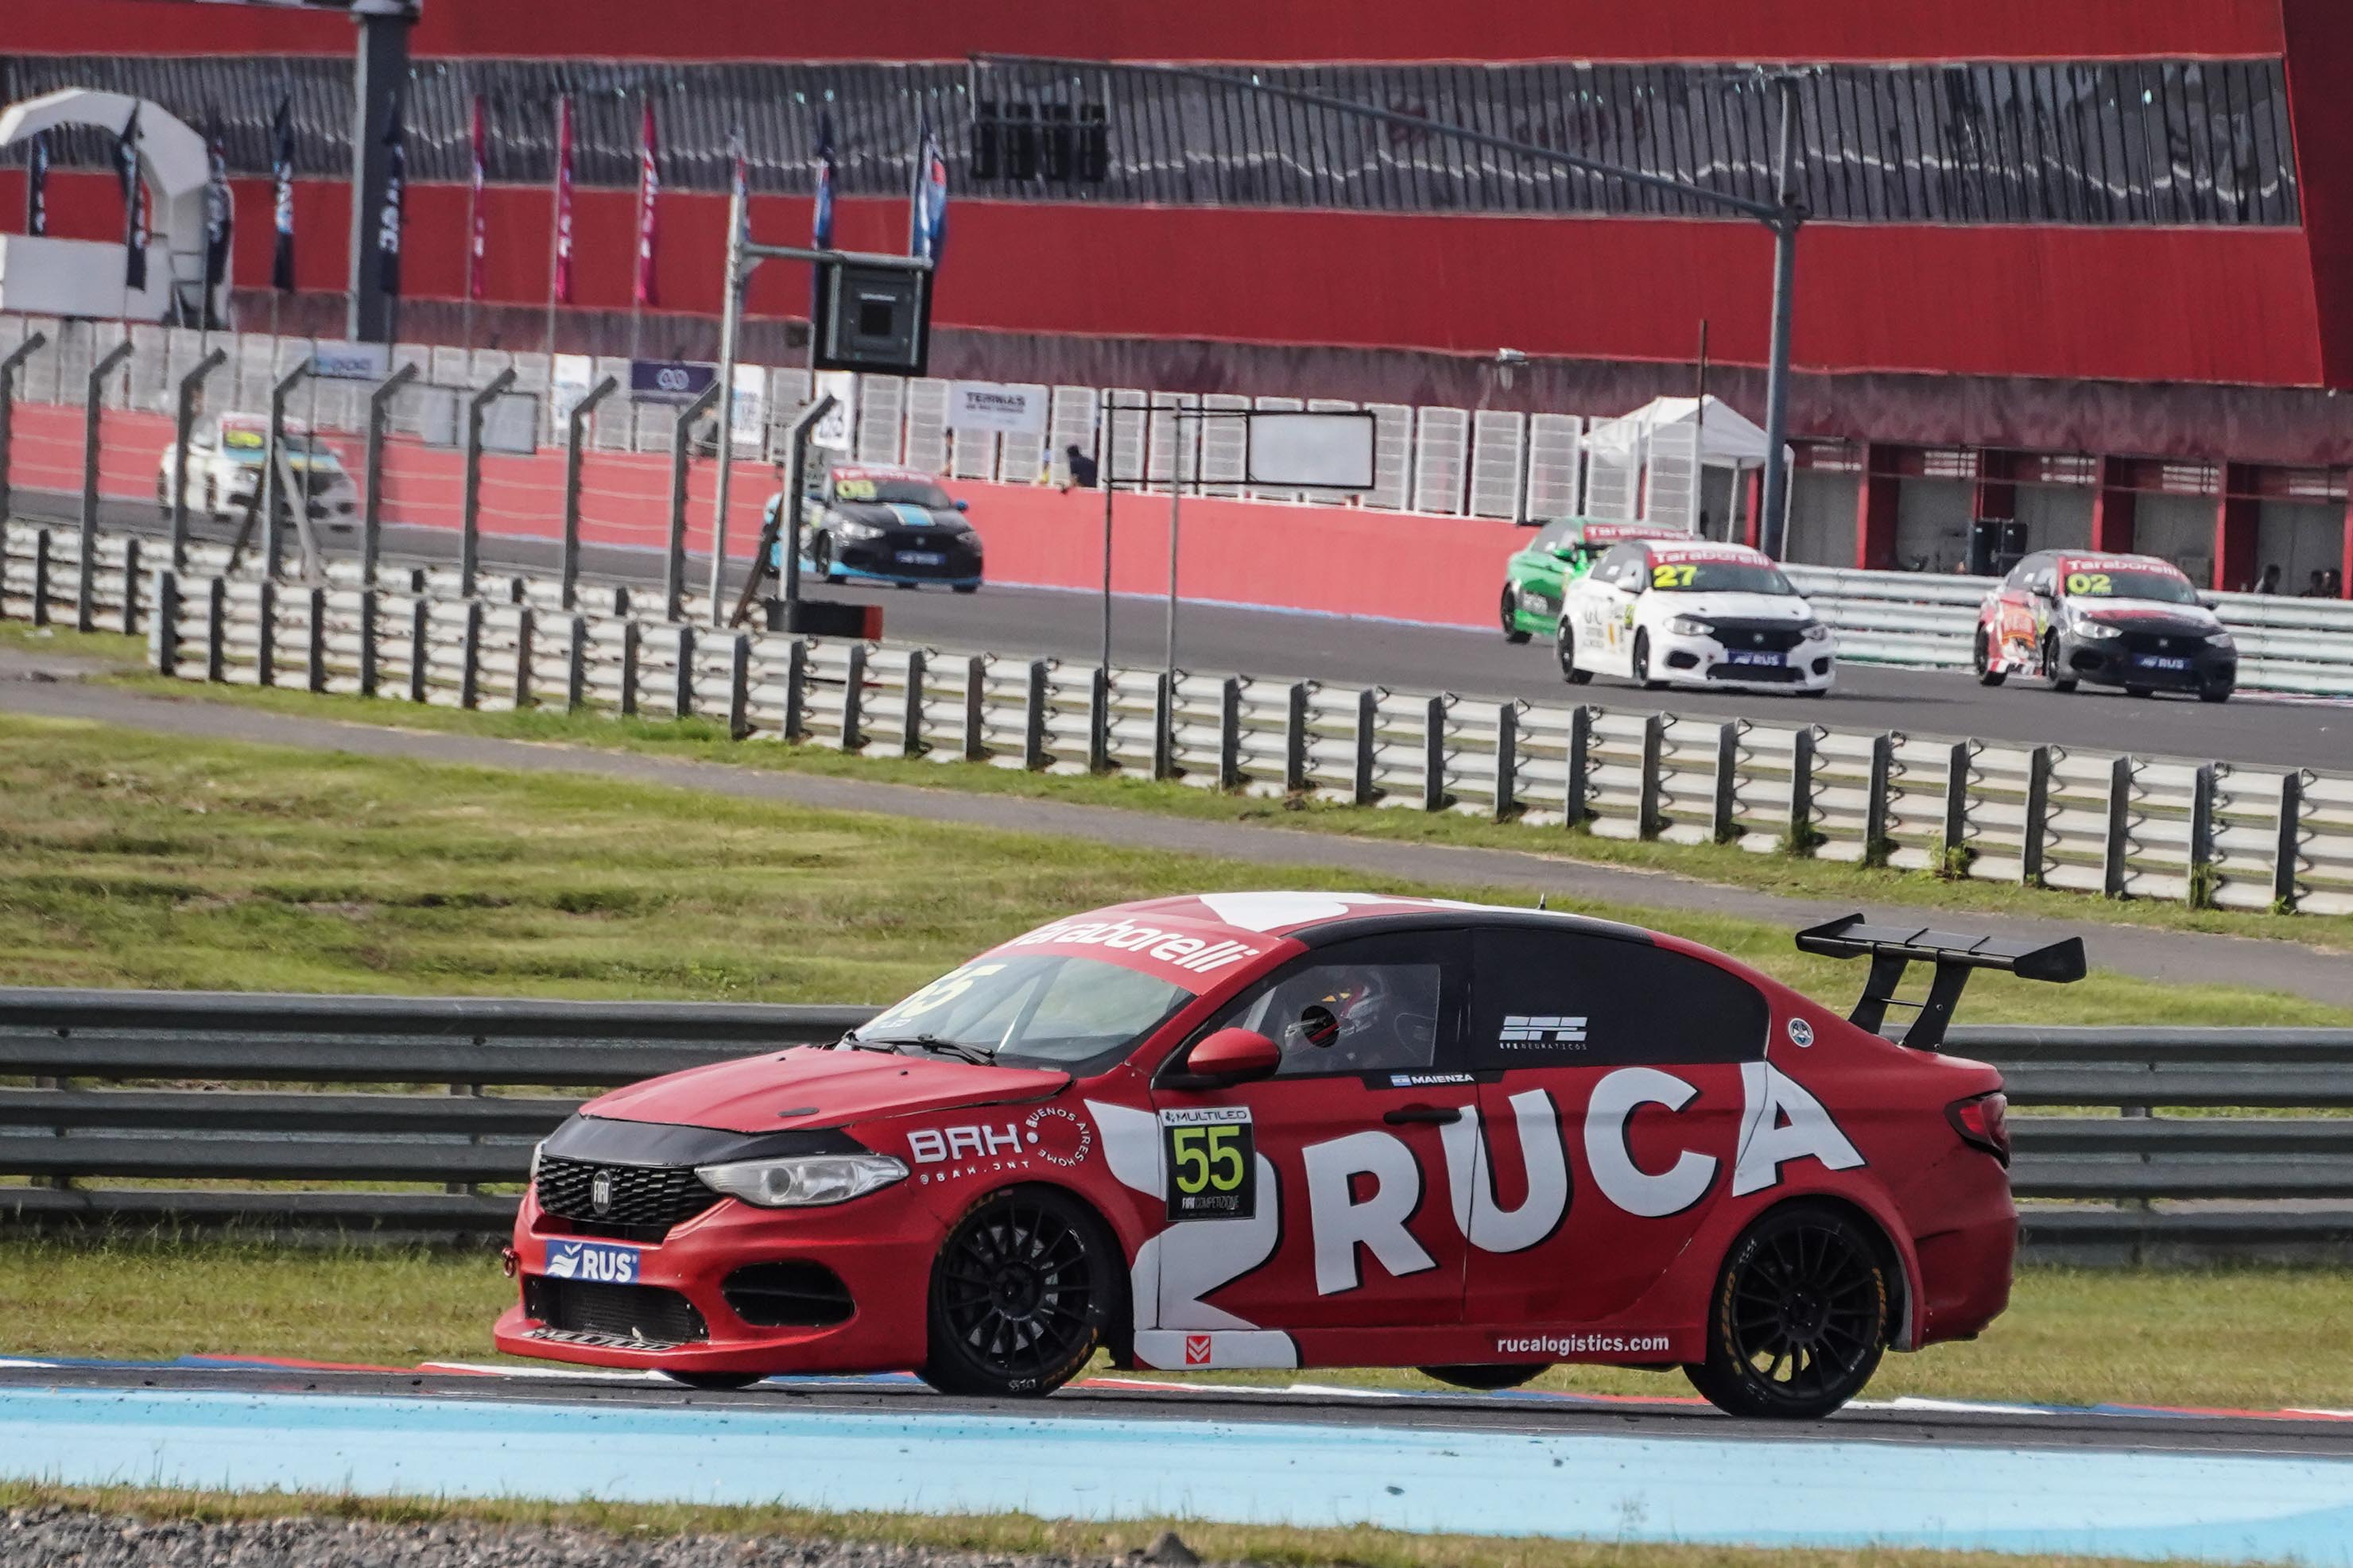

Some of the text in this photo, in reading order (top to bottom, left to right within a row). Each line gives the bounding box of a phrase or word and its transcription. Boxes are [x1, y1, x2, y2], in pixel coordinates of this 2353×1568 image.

[1653, 550, 1770, 567] Taraborelli
[2067, 559, 2179, 576] Taraborelli
[1653, 564, 1697, 587] 27
[2068, 573, 2112, 594] 02
[2158, 658, 2185, 669] RUS
[1411, 1074, 1475, 1085] MAIENZA
[1176, 1110, 1247, 1122] MULTILED
[906, 1124, 1023, 1163] BAH
[1025, 1108, 1093, 1167] BUENOS AIRES HOME
[1173, 1125, 1244, 1194] 55
[1301, 1061, 1867, 1295] RUCA
[582, 1249, 633, 1282] RUS
[1498, 1334, 1669, 1357] rucalogistics.com
